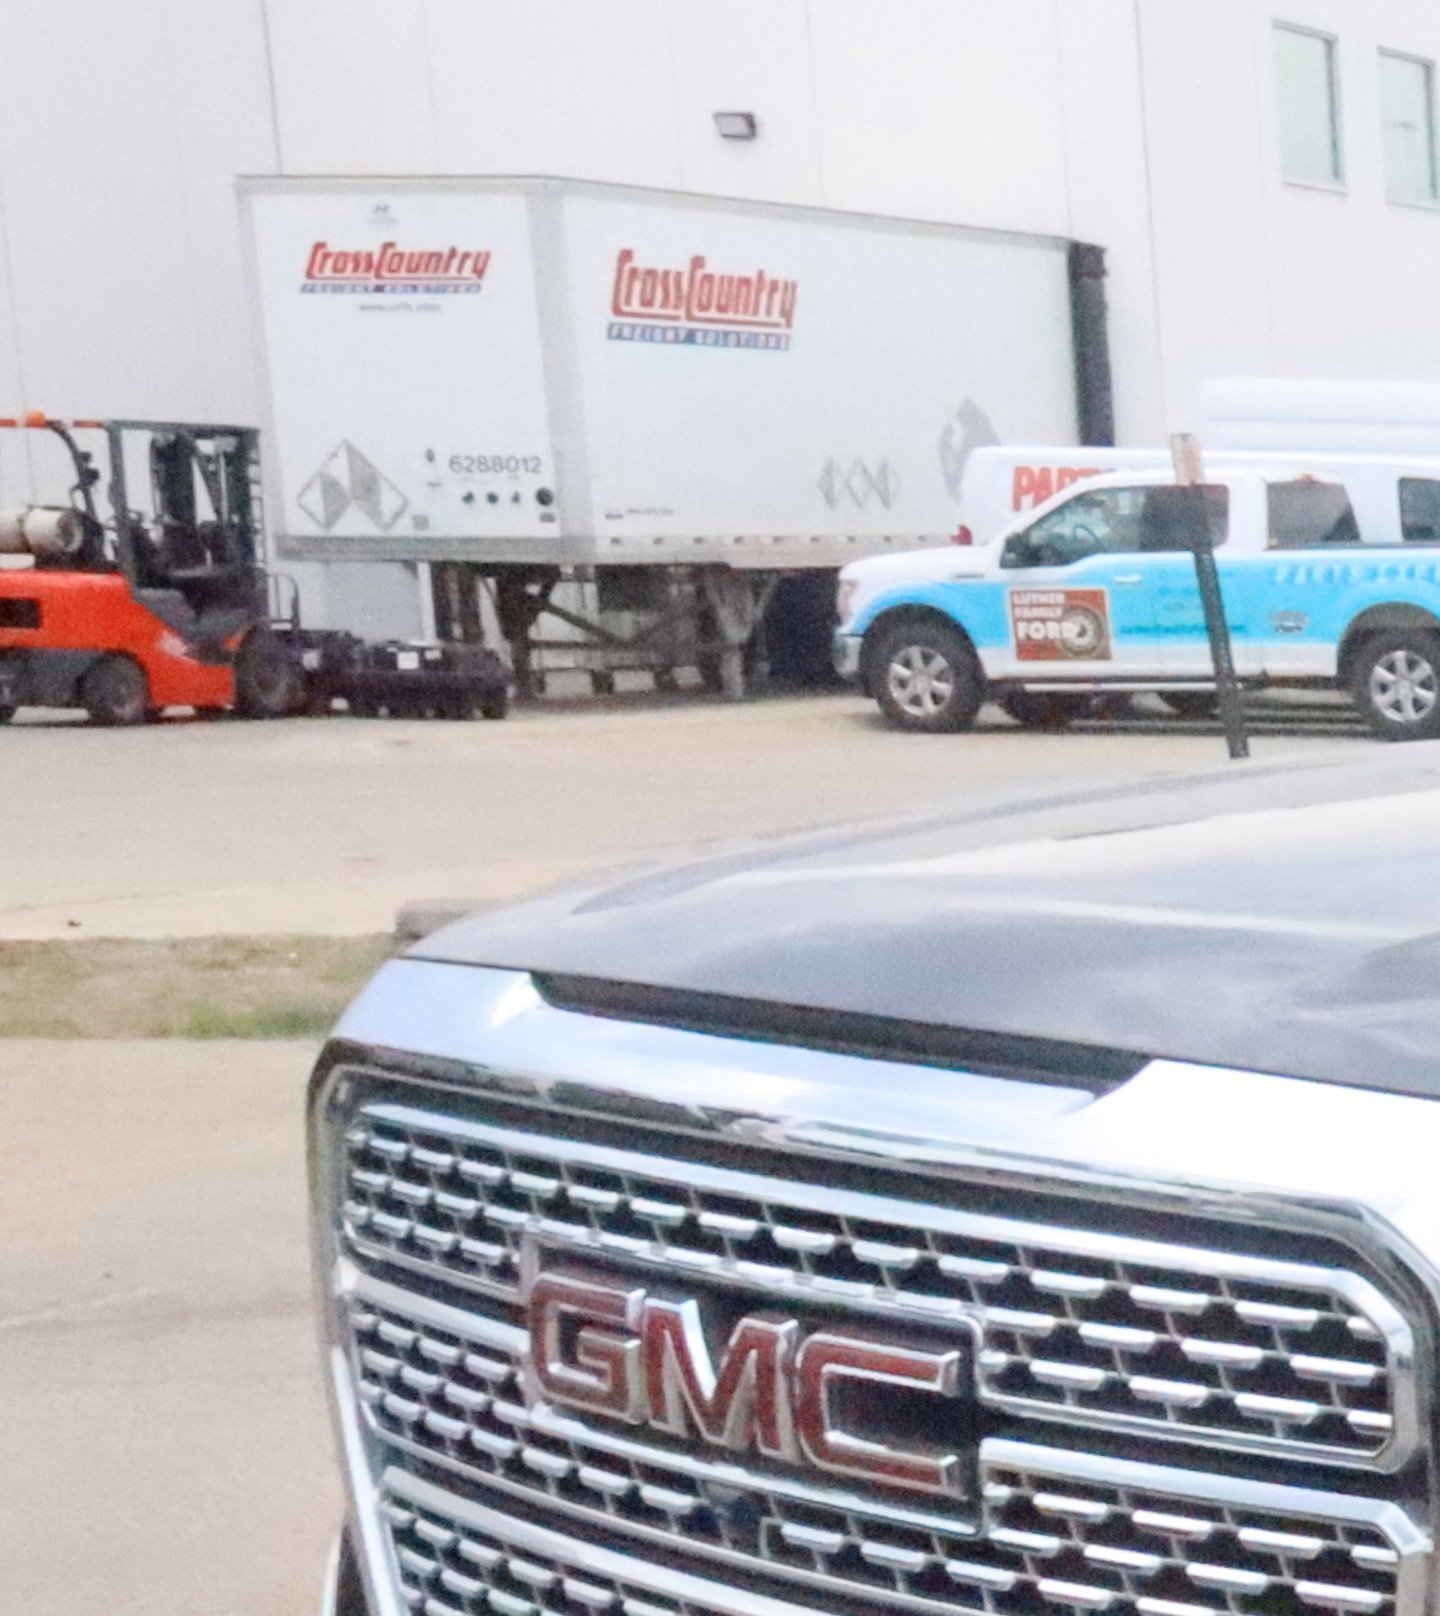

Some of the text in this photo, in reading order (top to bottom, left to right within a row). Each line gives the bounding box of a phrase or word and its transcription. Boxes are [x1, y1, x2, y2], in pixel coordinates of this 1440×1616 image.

[449, 455, 542, 474] 6288012
[1017, 621, 1078, 640] FORD
[529, 1271, 968, 1501] GMC
